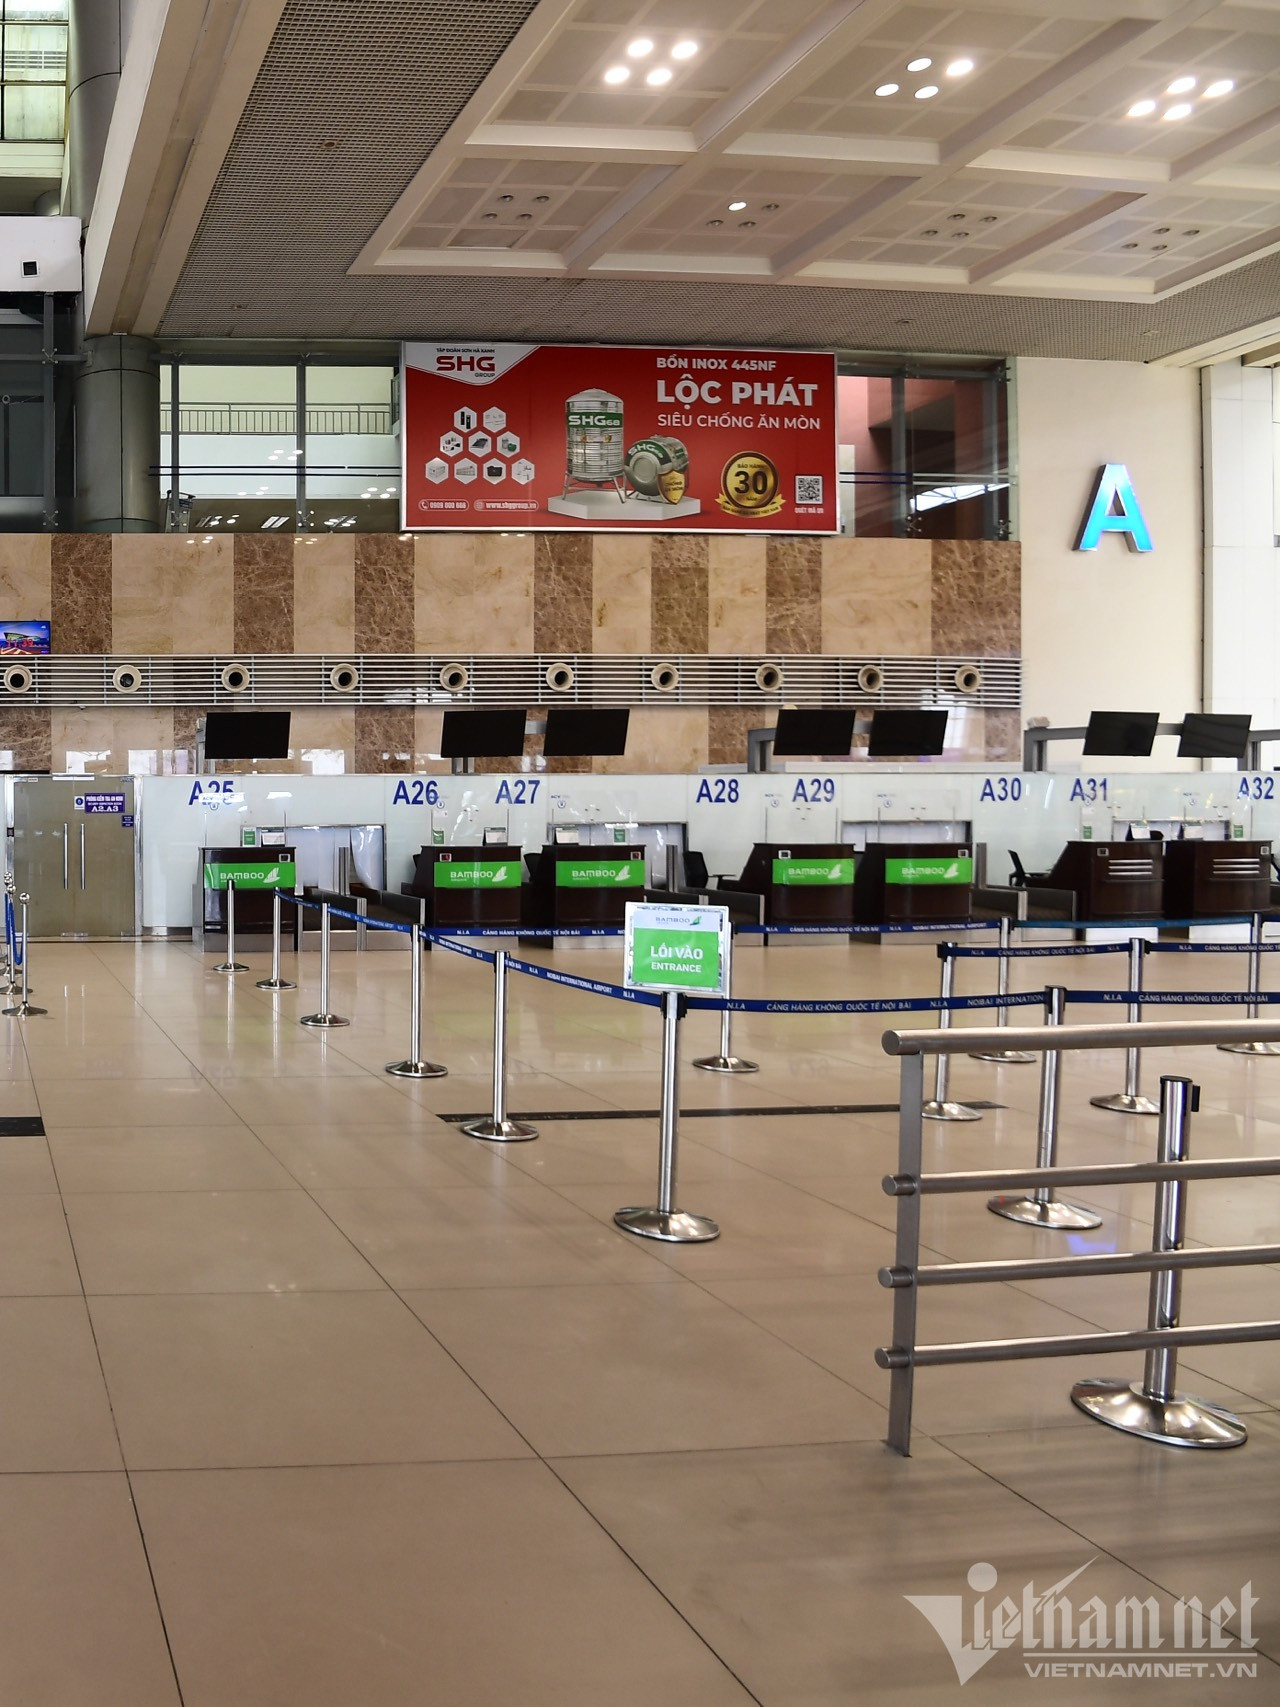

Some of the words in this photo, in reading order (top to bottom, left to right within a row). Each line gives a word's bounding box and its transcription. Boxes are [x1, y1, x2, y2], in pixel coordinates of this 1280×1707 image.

[436, 355, 495, 371] SHG
[656, 354, 688, 369] BỒN
[692, 358, 727, 370] INOX
[731, 359, 777, 371] 445NF
[656, 373, 722, 410] LỘC
[731, 376, 818, 406] PHÁT
[657, 412, 692, 427] SIÊU
[696, 411, 753, 428] CHỐNG
[757, 413, 780, 429] ĂN
[783, 415, 820, 430] MÒN
[733, 470, 768, 495] 30
[1072, 463, 1153, 552] A
[393, 780, 438, 805] A26
[495, 780, 540, 804] A27
[696, 779, 739, 803] A28
[792, 779, 835, 802] A29
[980, 777, 1021, 801] A30
[1070, 778, 1108, 801] A31
[1239, 777, 1274, 800] A32
[220, 872, 264, 880] BAMBOO
[450, 870, 493, 880] BAMBOO
[572, 870, 616, 879] BAMBOO
[788, 867, 829, 877] BAMBOO
[650, 942, 672, 958] LỐI
[674, 944, 704, 960] VÀO
[651, 962, 702, 973] ENTRANCE
[727, 1002, 746, 1010] N.I.A
[995, 994, 1045, 1004] INTERNATION
